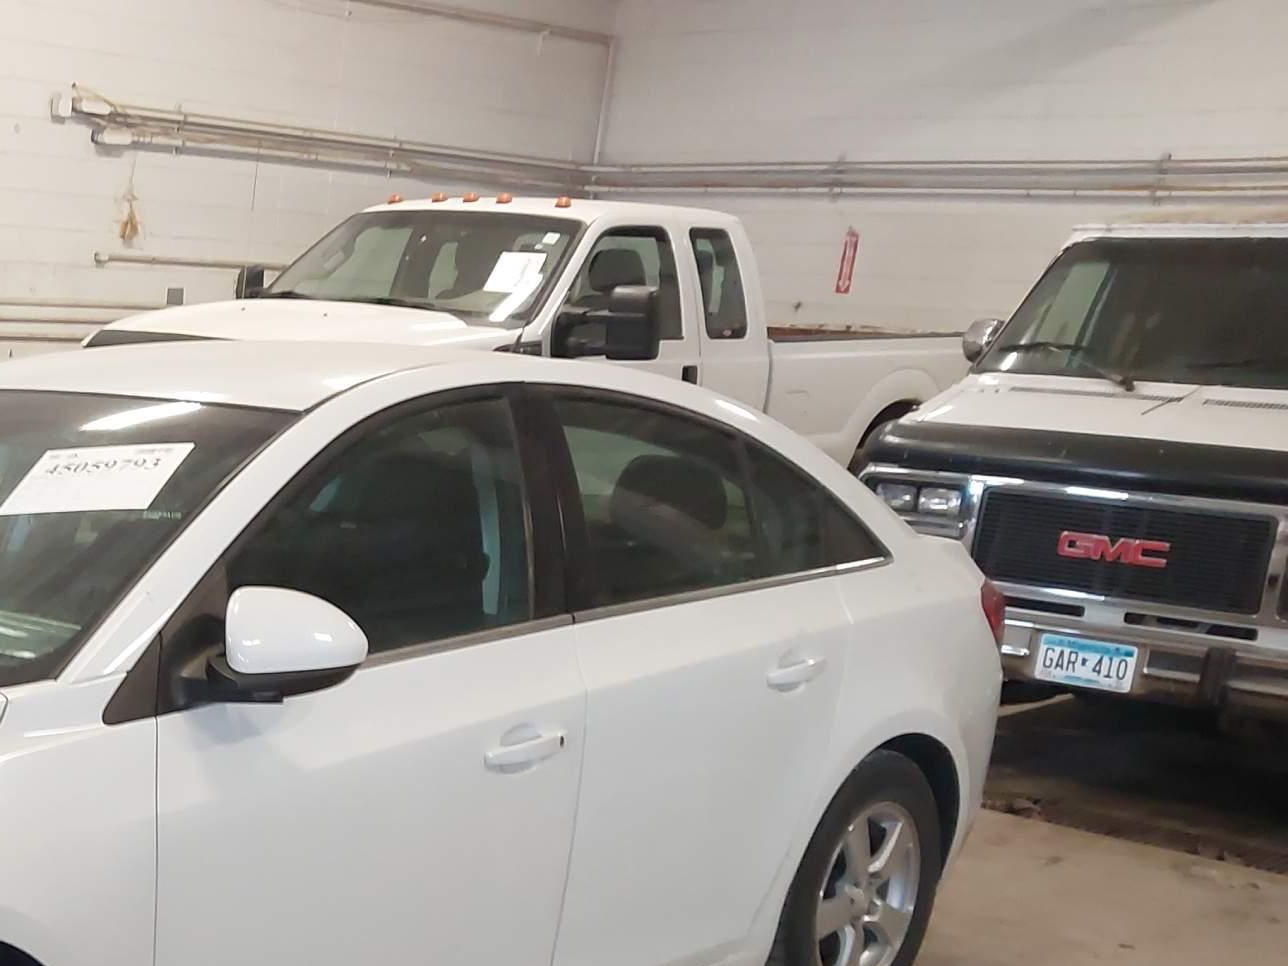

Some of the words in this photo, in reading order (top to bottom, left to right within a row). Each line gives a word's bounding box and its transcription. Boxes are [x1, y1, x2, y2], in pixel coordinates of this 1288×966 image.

[1057, 530, 1172, 568] GMC
[1042, 647, 1079, 673] GAR
[1092, 654, 1129, 681] 410
